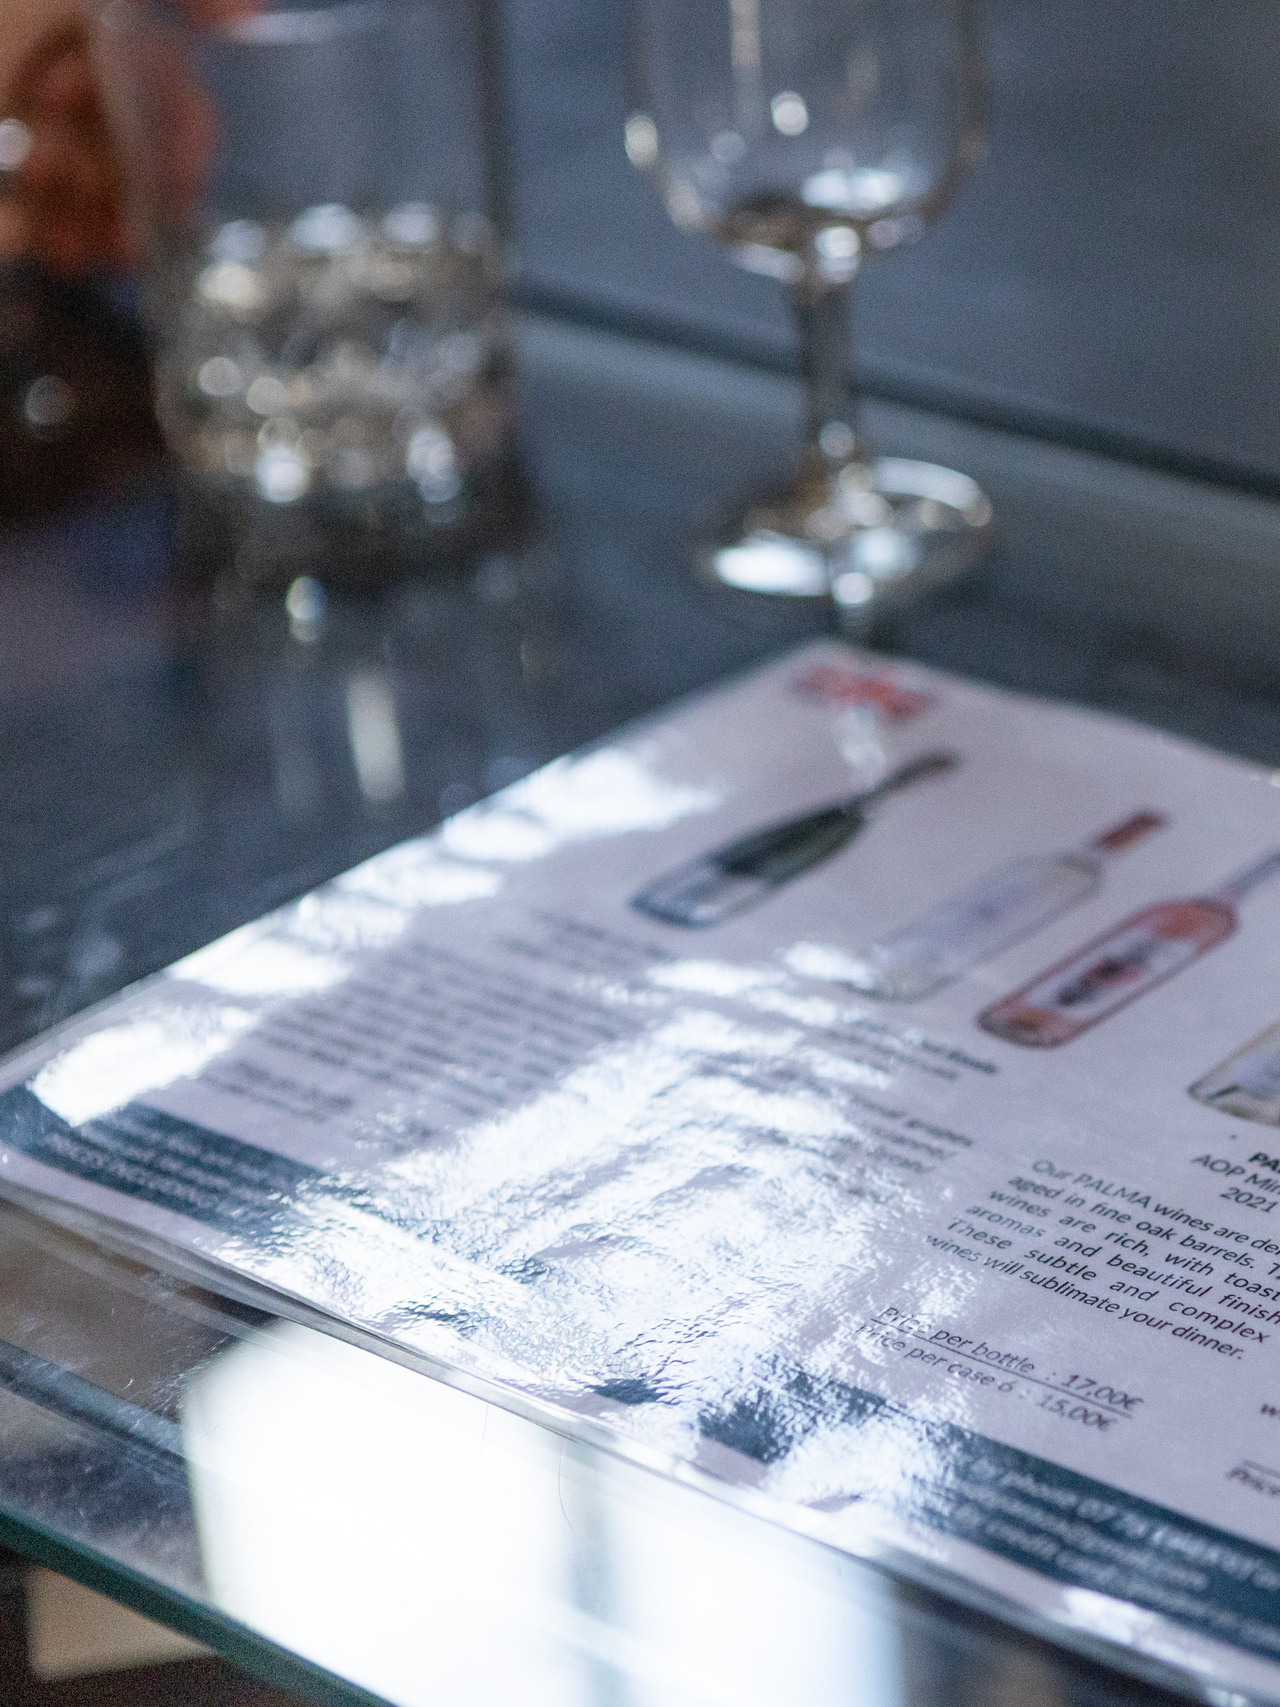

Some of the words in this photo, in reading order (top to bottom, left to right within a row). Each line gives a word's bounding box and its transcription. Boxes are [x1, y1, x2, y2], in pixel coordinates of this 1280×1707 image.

[1031, 1159, 1073, 1181] Our
[1073, 1173, 1153, 1208] PALMA
[1153, 1203, 1214, 1232] wines
[1213, 1226, 1250, 1244] are
[1192, 1154, 1246, 1177] AOP
[1219, 1187, 1280, 1214] 2021
[965, 1204, 1047, 1238] aromas
[1053, 1236, 1103, 1259] and
[1106, 1253, 1214, 1298] beautiful
[989, 1190, 1052, 1218] wines
[1058, 1215, 1097, 1233] are
[1103, 1231, 1150, 1257] rich,
[1164, 1253, 1214, 1276] with
[1008, 1176, 1065, 1199] aged
[1064, 1193, 1087, 1208] in
[1089, 1202, 1132, 1224] fine
[1135, 1220, 1178, 1241] oak
[1179, 1234, 1254, 1269] barrels.
[925, 1235, 982, 1262] wines
[983, 1256, 1025, 1276] will
[1019, 1269, 1121, 1314] sublimate
[1118, 1308, 1174, 1330] your
[1171, 1325, 1244, 1360] dinner.
[946, 1218, 1013, 1250] These
[1023, 1249, 1098, 1281] subtle
[1109, 1281, 1160, 1302] and
[1168, 1301, 1270, 1344] complex
[903, 1348, 949, 1366] per
[947, 1362, 996, 1386] case
[998, 1380, 1014, 1393] 6
[930, 1329, 972, 1349] per
[971, 1342, 1035, 1373] bottle
